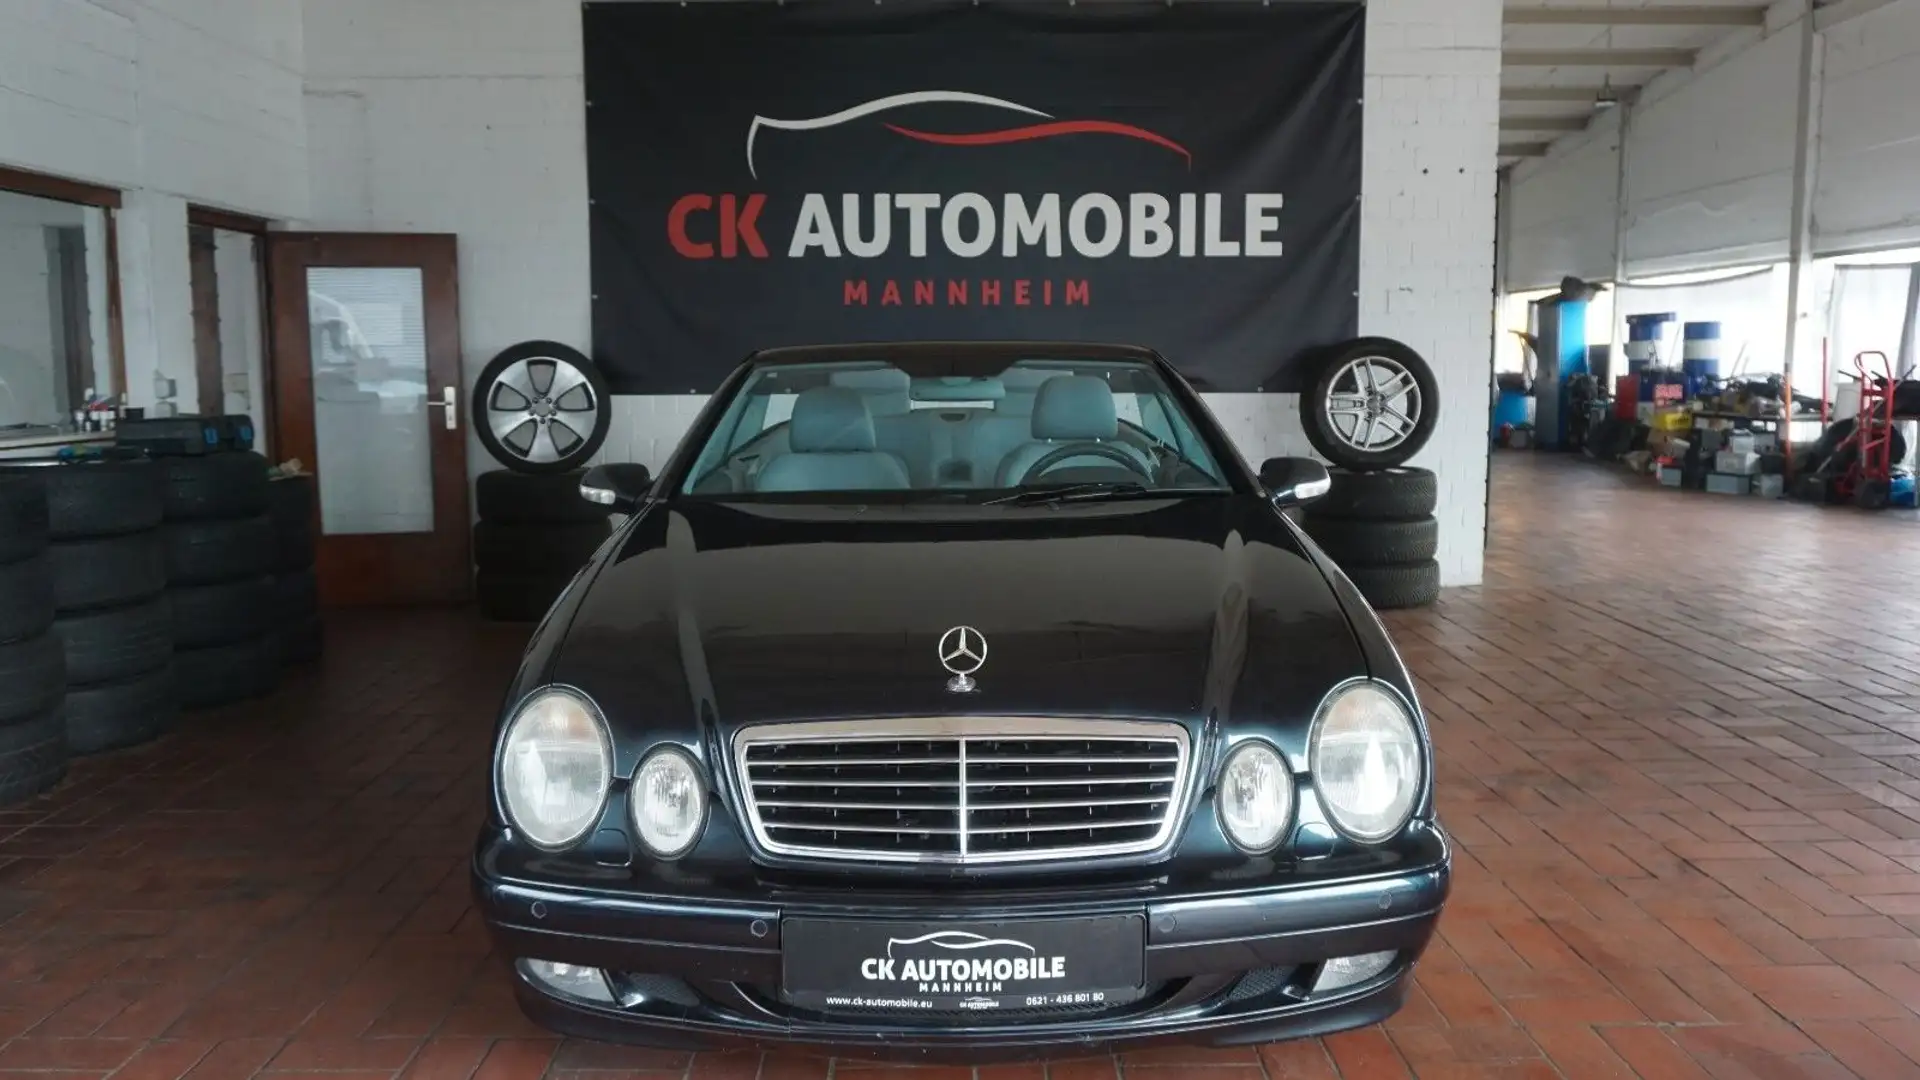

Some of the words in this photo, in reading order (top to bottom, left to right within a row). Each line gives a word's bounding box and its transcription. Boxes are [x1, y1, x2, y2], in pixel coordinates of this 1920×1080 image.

[667, 193, 768, 258] CK
[788, 192, 1284, 258] AUTOMOBILE
[844, 279, 1090, 306] MANNHEIM
[861, 958, 896, 980] CK
[901, 957, 1066, 981] AUTOMOBILE
[919, 982, 1002, 992] MANNHEIM
[826, 996, 933, 1008] www.ck-automobile.eu
[1026, 996, 1047, 1006] 0621
[1056, 994, 1072, 1003] 436
[1075, 993, 1090, 1002] 801
[1093, 992, 1104, 1000] 80
